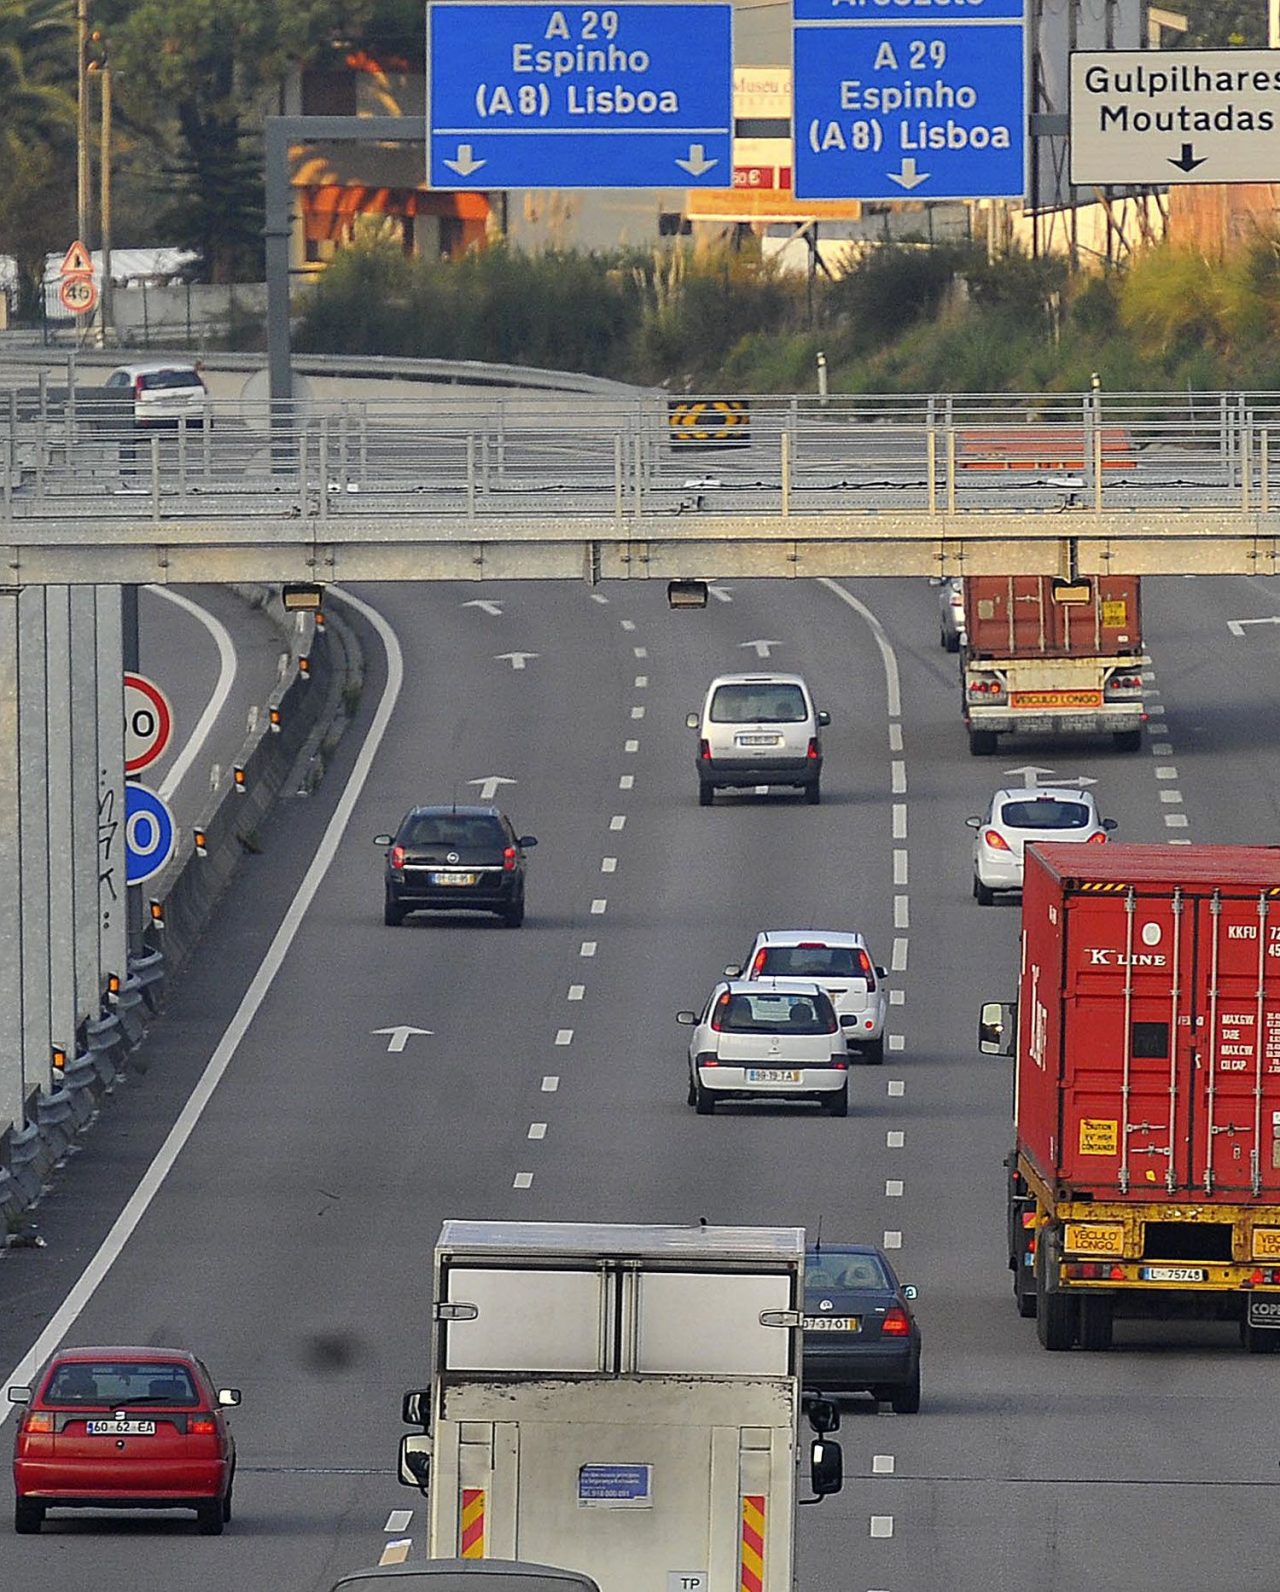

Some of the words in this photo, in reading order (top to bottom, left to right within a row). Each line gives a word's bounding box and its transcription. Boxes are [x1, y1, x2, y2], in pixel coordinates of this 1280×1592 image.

[512, 44, 650, 76] Espinho
[567, 85, 678, 114] Lisboa
[840, 80, 977, 114] Espinho
[1100, 104, 1275, 132] Moutadas
[901, 120, 1010, 149] Lisboa
[1228, 926, 1257, 939] KKFU
[1116, 954, 1167, 966] LINE
[1075, 1240, 1114, 1250] LONGO
[681, 1578, 700, 1590] TP
